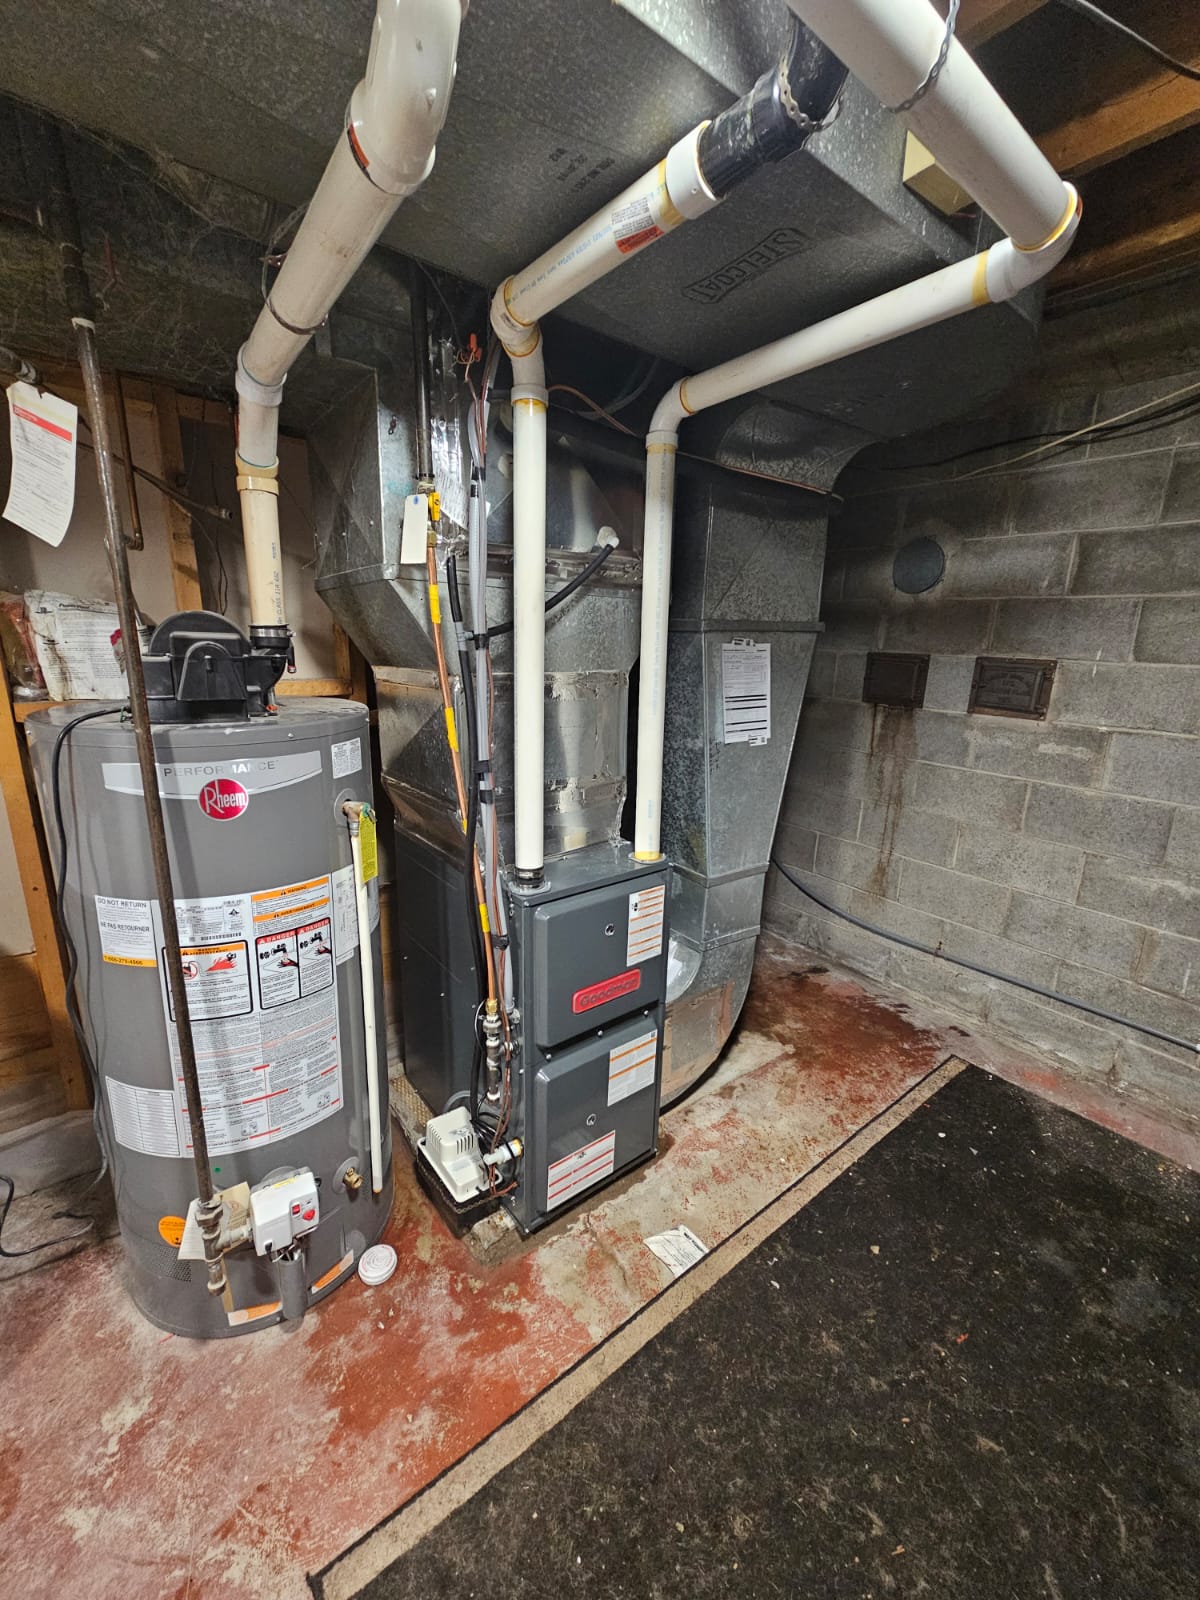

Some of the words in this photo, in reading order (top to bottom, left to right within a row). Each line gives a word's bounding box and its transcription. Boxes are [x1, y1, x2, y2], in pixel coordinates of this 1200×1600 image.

[690, 231, 803, 301] STELCOAT
[204, 779, 246, 814] Rheem
[120, 900, 147, 908] RETURN
[107, 922, 117, 930] PAS
[117, 924, 150, 932] RETOURNER
